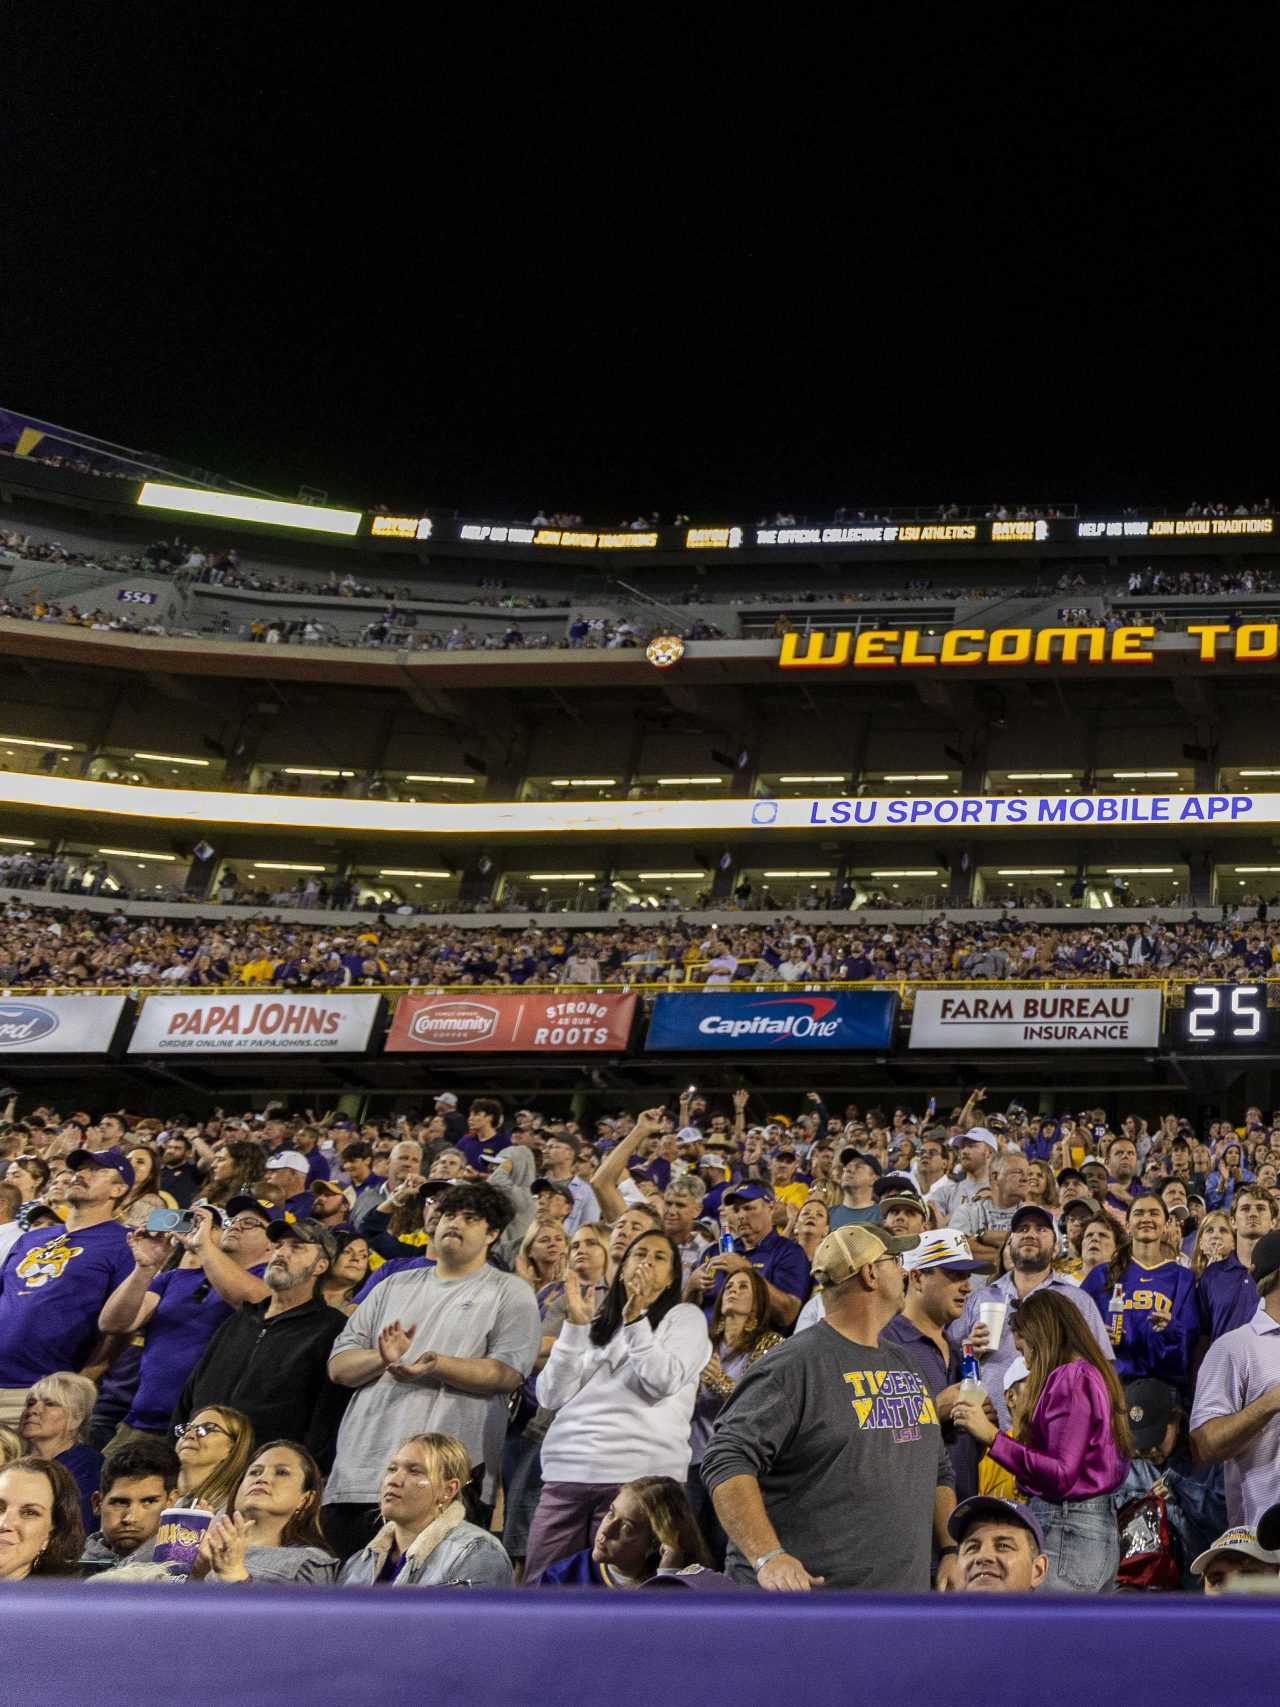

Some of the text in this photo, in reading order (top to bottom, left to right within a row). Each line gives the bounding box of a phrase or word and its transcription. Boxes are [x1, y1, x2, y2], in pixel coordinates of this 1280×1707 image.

[899, 527, 920, 540] LSU
[920, 525, 976, 539] ATHLETICS
[992, 521, 1034, 535] BAYOU
[1079, 522, 1105, 536] HELP
[1150, 521, 1174, 535] JOIN
[1176, 520, 1210, 534] BAYOU
[1212, 519, 1272, 533] TRADITIONS
[122, 591, 151, 604] 554
[779, 626, 1154, 667] WELCOME
[1187, 623, 1279, 662] TO
[809, 801, 878, 824] LSU
[886, 799, 1028, 823] SPORTS
[1037, 797, 1171, 822] MOBILE
[1179, 796, 1253, 820] APP
[546, 1001, 608, 1019] STRONG
[940, 997, 1130, 1019] FARM BUREAU
[1189, 987, 1261, 1036] 25
[167, 1003, 341, 1035] PAPA JOHNS
[415, 1015, 493, 1034] Community
[534, 1028, 608, 1045] ROOTS
[1023, 1025, 1128, 1041] INSURANCE
[158, 1039, 338, 1048] ORDER ONLINE AT PAPAJOHNS.COM
